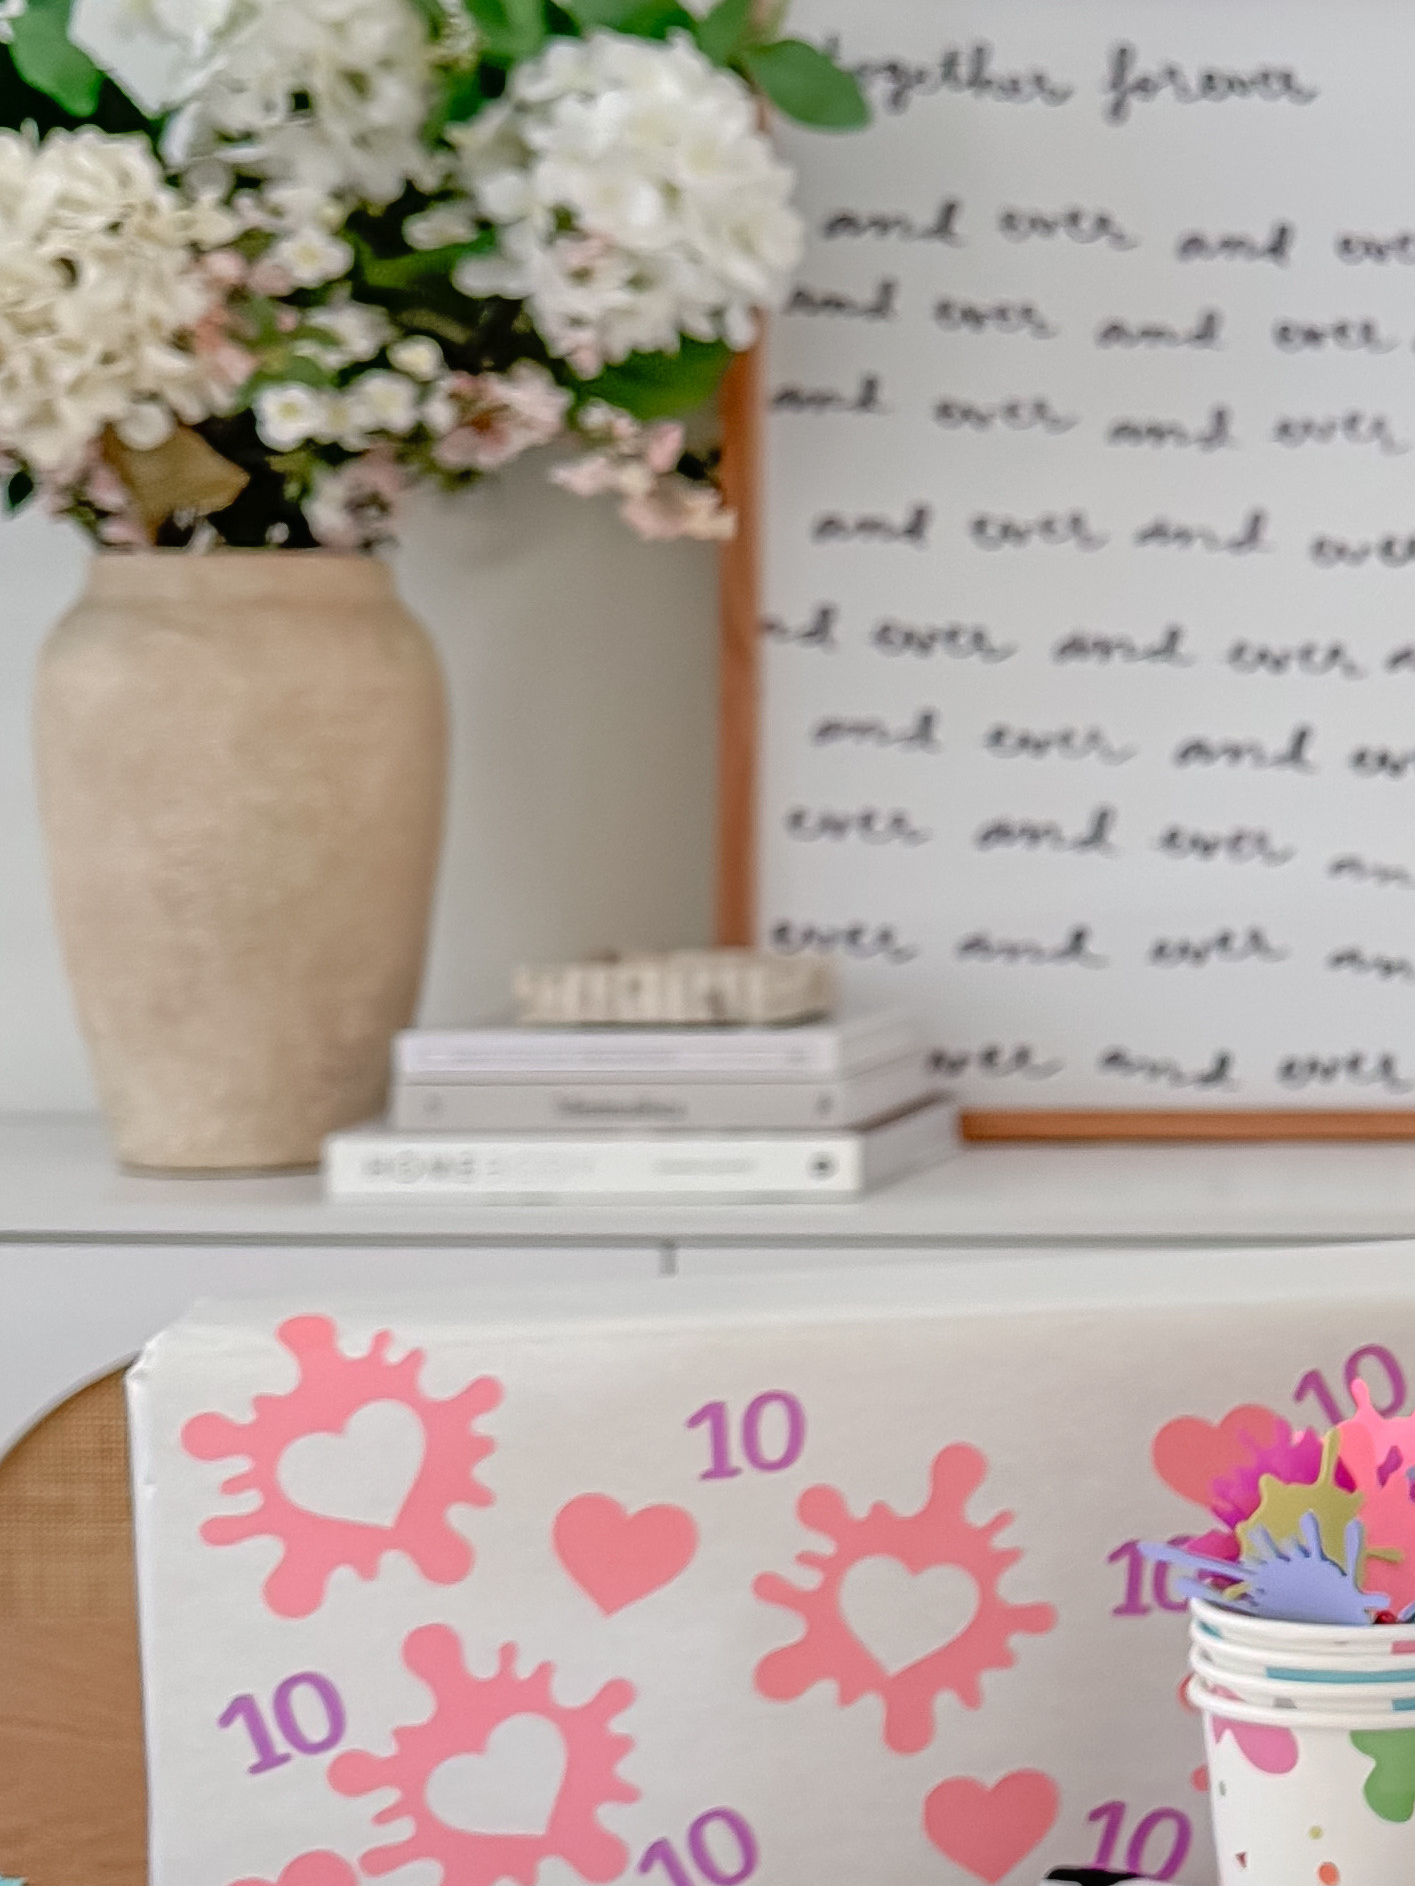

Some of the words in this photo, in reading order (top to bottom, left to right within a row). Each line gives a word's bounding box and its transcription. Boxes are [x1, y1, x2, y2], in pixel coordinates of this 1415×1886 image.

[1101, 40, 1320, 127] forever
[818, 195, 964, 247] and
[996, 205, 1139, 251] ever
[1173, 218, 1297, 268] and
[784, 274, 900, 323] and
[931, 295, 1058, 340] ever
[1093, 307, 1225, 350] and
[1270, 317, 1397, 354] ever
[765, 371, 886, 414] and
[931, 396, 1078, 434] ever
[1104, 404, 1234, 453] and
[1271, 409, 1408, 455] ever
[809, 500, 935, 549] and
[967, 509, 1109, 552] ever
[1132, 506, 1269, 556] and
[760, 600, 840, 652] nd
[868, 617, 1017, 664] ever
[1050, 622, 1195, 667] and
[1223, 638, 1367, 680] ever
[809, 706, 941, 753] and
[982, 722, 1136, 765] ever
[1171, 721, 1317, 775] and
[783, 805, 930, 846] ever
[972, 804, 1118, 856] and
[1155, 823, 1295, 867] ever
[768, 918, 917, 969] ever
[953, 924, 1107, 969] and
[1146, 925, 1289, 968] ever
[922, 1043, 1062, 1089] ver
[1096, 1045, 1236, 1091] and
[1275, 1049, 1414, 1094] ever
[686, 1390, 806, 1481] 10
[218, 1671, 347, 1775] 10
[1084, 1800, 1193, 1882] 10
